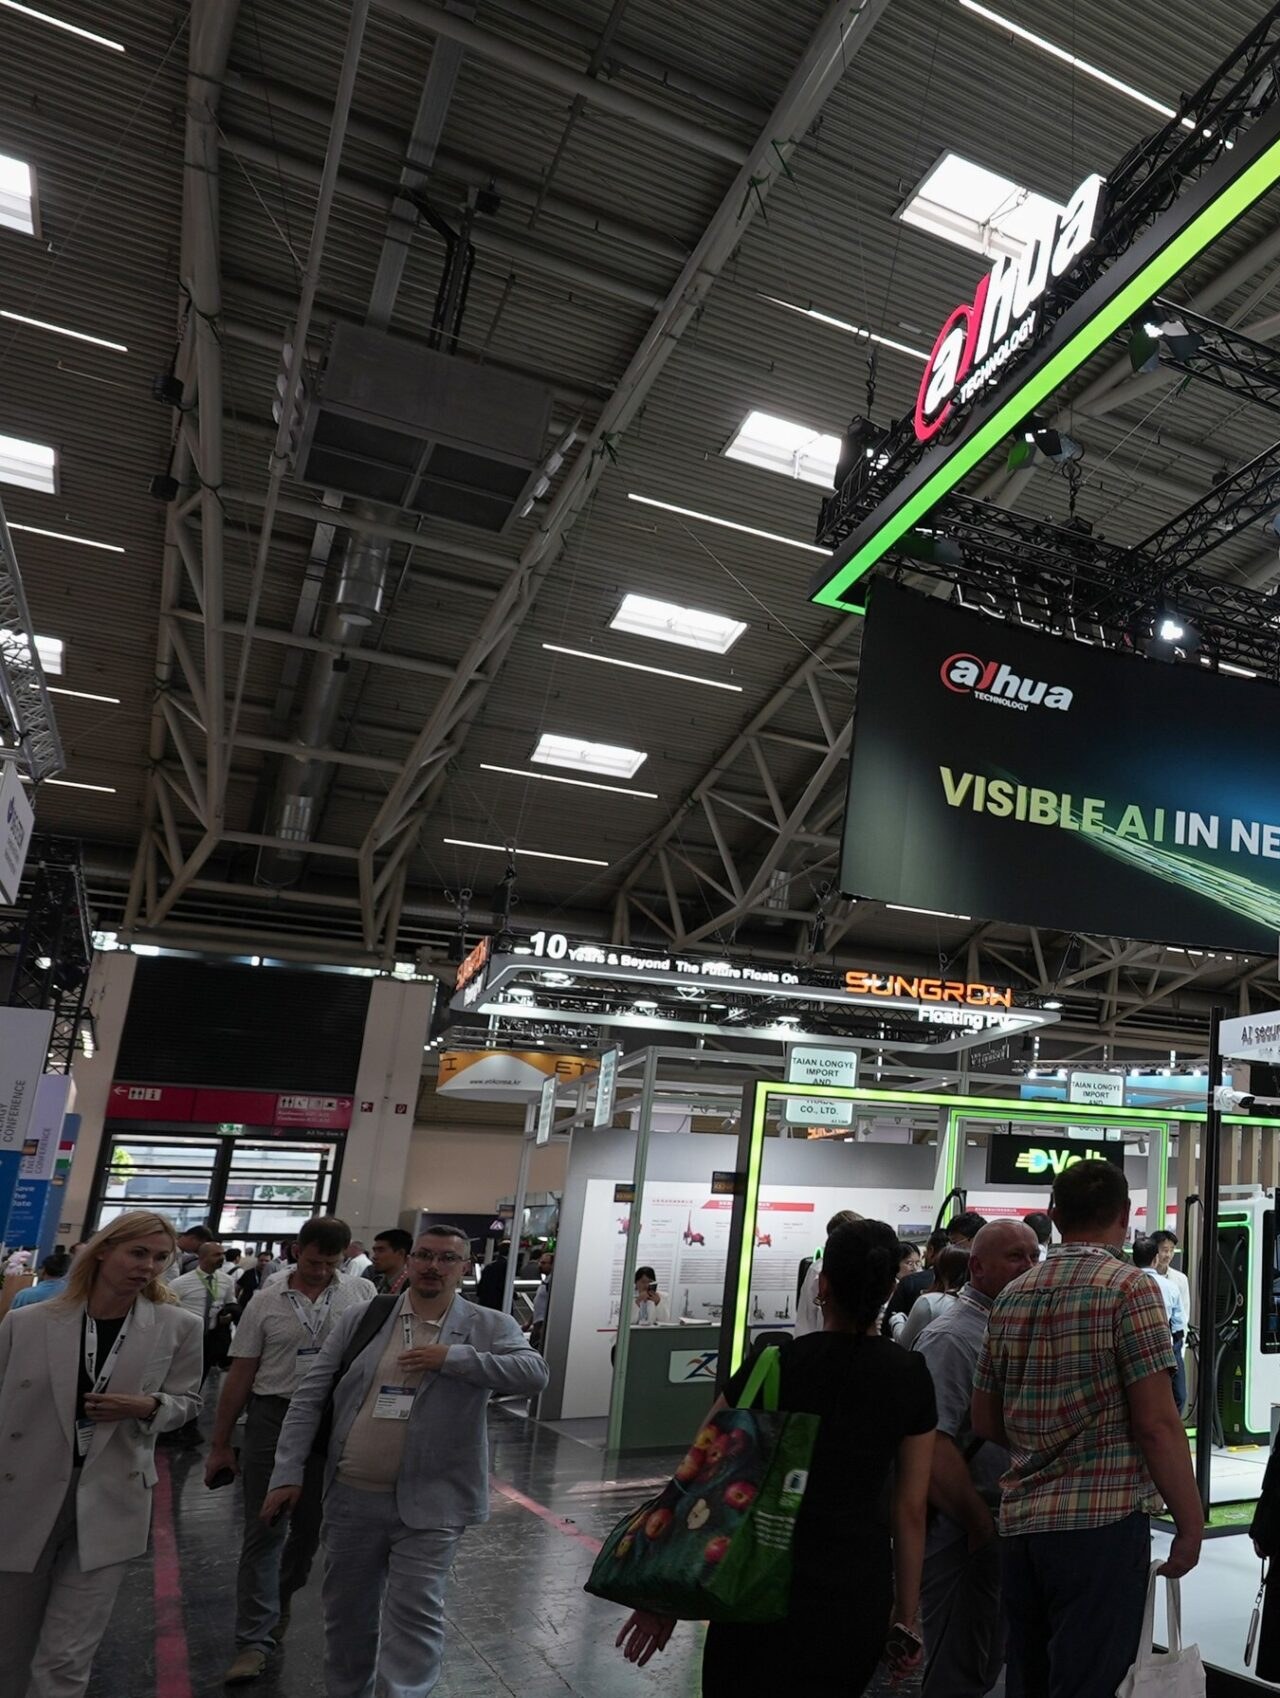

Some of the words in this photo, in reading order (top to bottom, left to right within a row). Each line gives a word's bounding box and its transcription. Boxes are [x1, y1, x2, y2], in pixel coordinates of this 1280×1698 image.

[960, 311, 1036, 404] TECHNOLOGY
[974, 691, 1029, 712] TECHNOLOGY
[939, 766, 1106, 834] VISIBLE
[1115, 804, 1165, 842] AI
[1175, 810, 1219, 849] IN
[530, 931, 568, 960] 10
[568, 948, 605, 964] Years
[607, 953, 619, 965] &
[621, 954, 671, 971] Beyond
[676, 960, 700, 974] The
[702, 963, 741, 979] Future
[742, 969, 779, 984] Floats
[781, 973, 799, 985] On
[845, 971, 1012, 1007] SUNGROW
[918, 1007, 985, 1030] Floating
[1241, 1026, 1252, 1041] AI
[792, 1057, 817, 1066] TAIAN
[820, 1060, 854, 1069] LONGYE
[806, 1068, 839, 1077] IMPORT
[1072, 1081, 1091, 1089] TAIAN
[1083, 1091, 1110, 1099] IMPORT
[3, 1079, 26, 1143] CONFERENCE
[820, 1107, 839, 1115] LTD.
